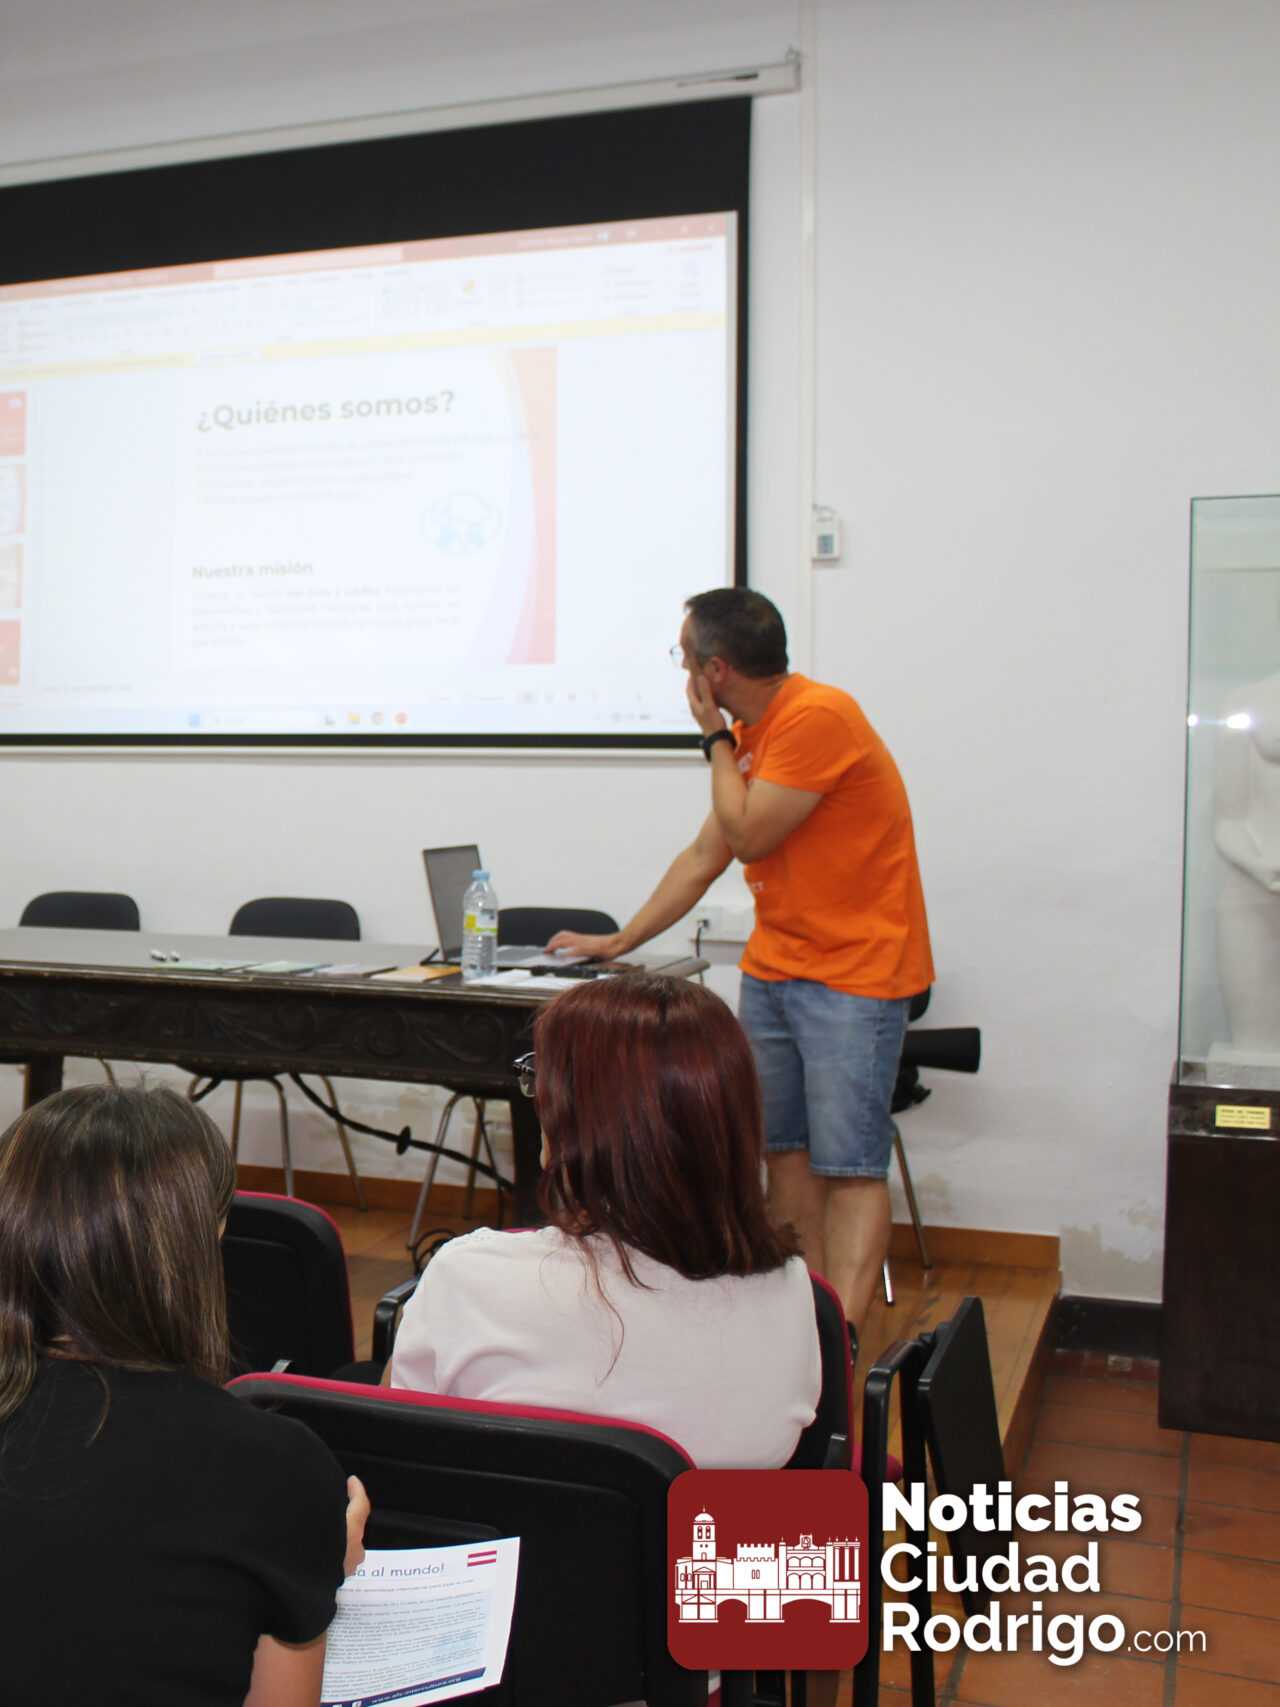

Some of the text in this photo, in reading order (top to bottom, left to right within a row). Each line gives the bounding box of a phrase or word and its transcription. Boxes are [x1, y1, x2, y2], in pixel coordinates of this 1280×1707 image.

[197, 389, 455, 432] ¿Quiénes somos?
[390, 1562, 445, 1577] mundo!
